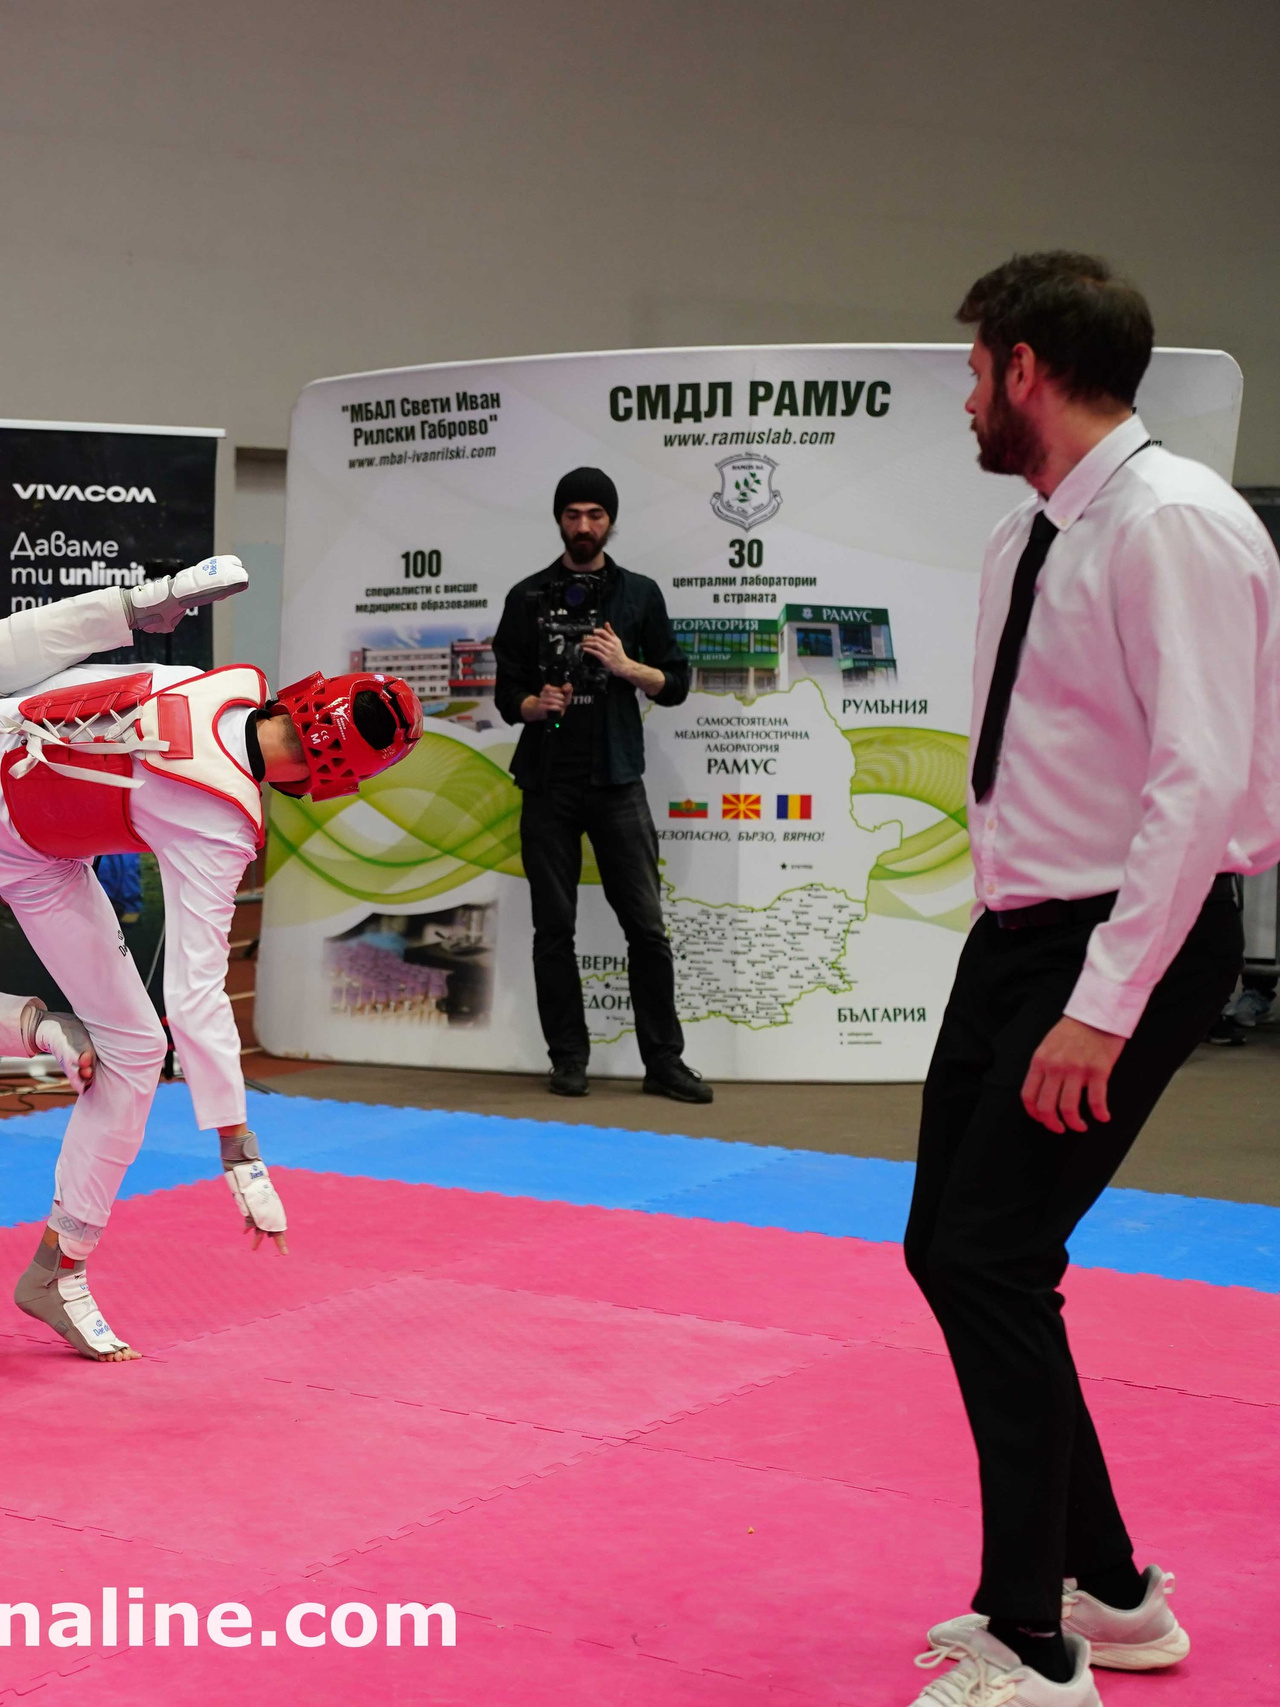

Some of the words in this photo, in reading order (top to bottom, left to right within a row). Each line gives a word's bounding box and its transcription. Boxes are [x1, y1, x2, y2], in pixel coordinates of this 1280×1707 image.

[342, 399, 396, 423] "МБАЛ
[400, 397, 451, 418] Свети
[456, 391, 501, 412] Иван
[609, 382, 733, 424] СМДЛ
[748, 380, 892, 418] РАМУС
[353, 425, 416, 447] Рилски
[420, 414, 498, 440] Габрово"
[663, 427, 836, 448] www.ramuslab.com
[348, 446, 497, 469] www.mbal-ivanrilski.com
[12, 483, 157, 503] VIVACOM
[10, 530, 119, 561] Даваме
[728, 538, 764, 568] 30
[401, 549, 442, 579] 100
[672, 576, 737, 588] централни
[740, 574, 817, 587] лаборатории
[365, 584, 432, 598] специалисти
[444, 582, 478, 594] висше
[713, 594, 720, 603] в
[723, 592, 777, 604] страната
[420, 598, 488, 611] образование
[822, 607, 873, 623] РАМУС
[672, 619, 759, 632] БОРАТОРИЯ
[842, 698, 929, 715] РУМЪНИЯ
[696, 716, 789, 727] САМОСТОЯТЕЛНА
[674, 729, 810, 741] МЕДИКО-ДИАГНОСТИЧНА
[704, 743, 780, 754] ЛАБОРАТОРИЯ
[706, 757, 778, 776] РАМУС
[737, 831, 777, 843] БЪРЗО,
[782, 831, 825, 843] ВЯРНО!
[575, 955, 627, 972] ЕВЕРН
[582, 994, 631, 1011] ЕДОН
[837, 1007, 927, 1024] БЪЛГАРИЯ
